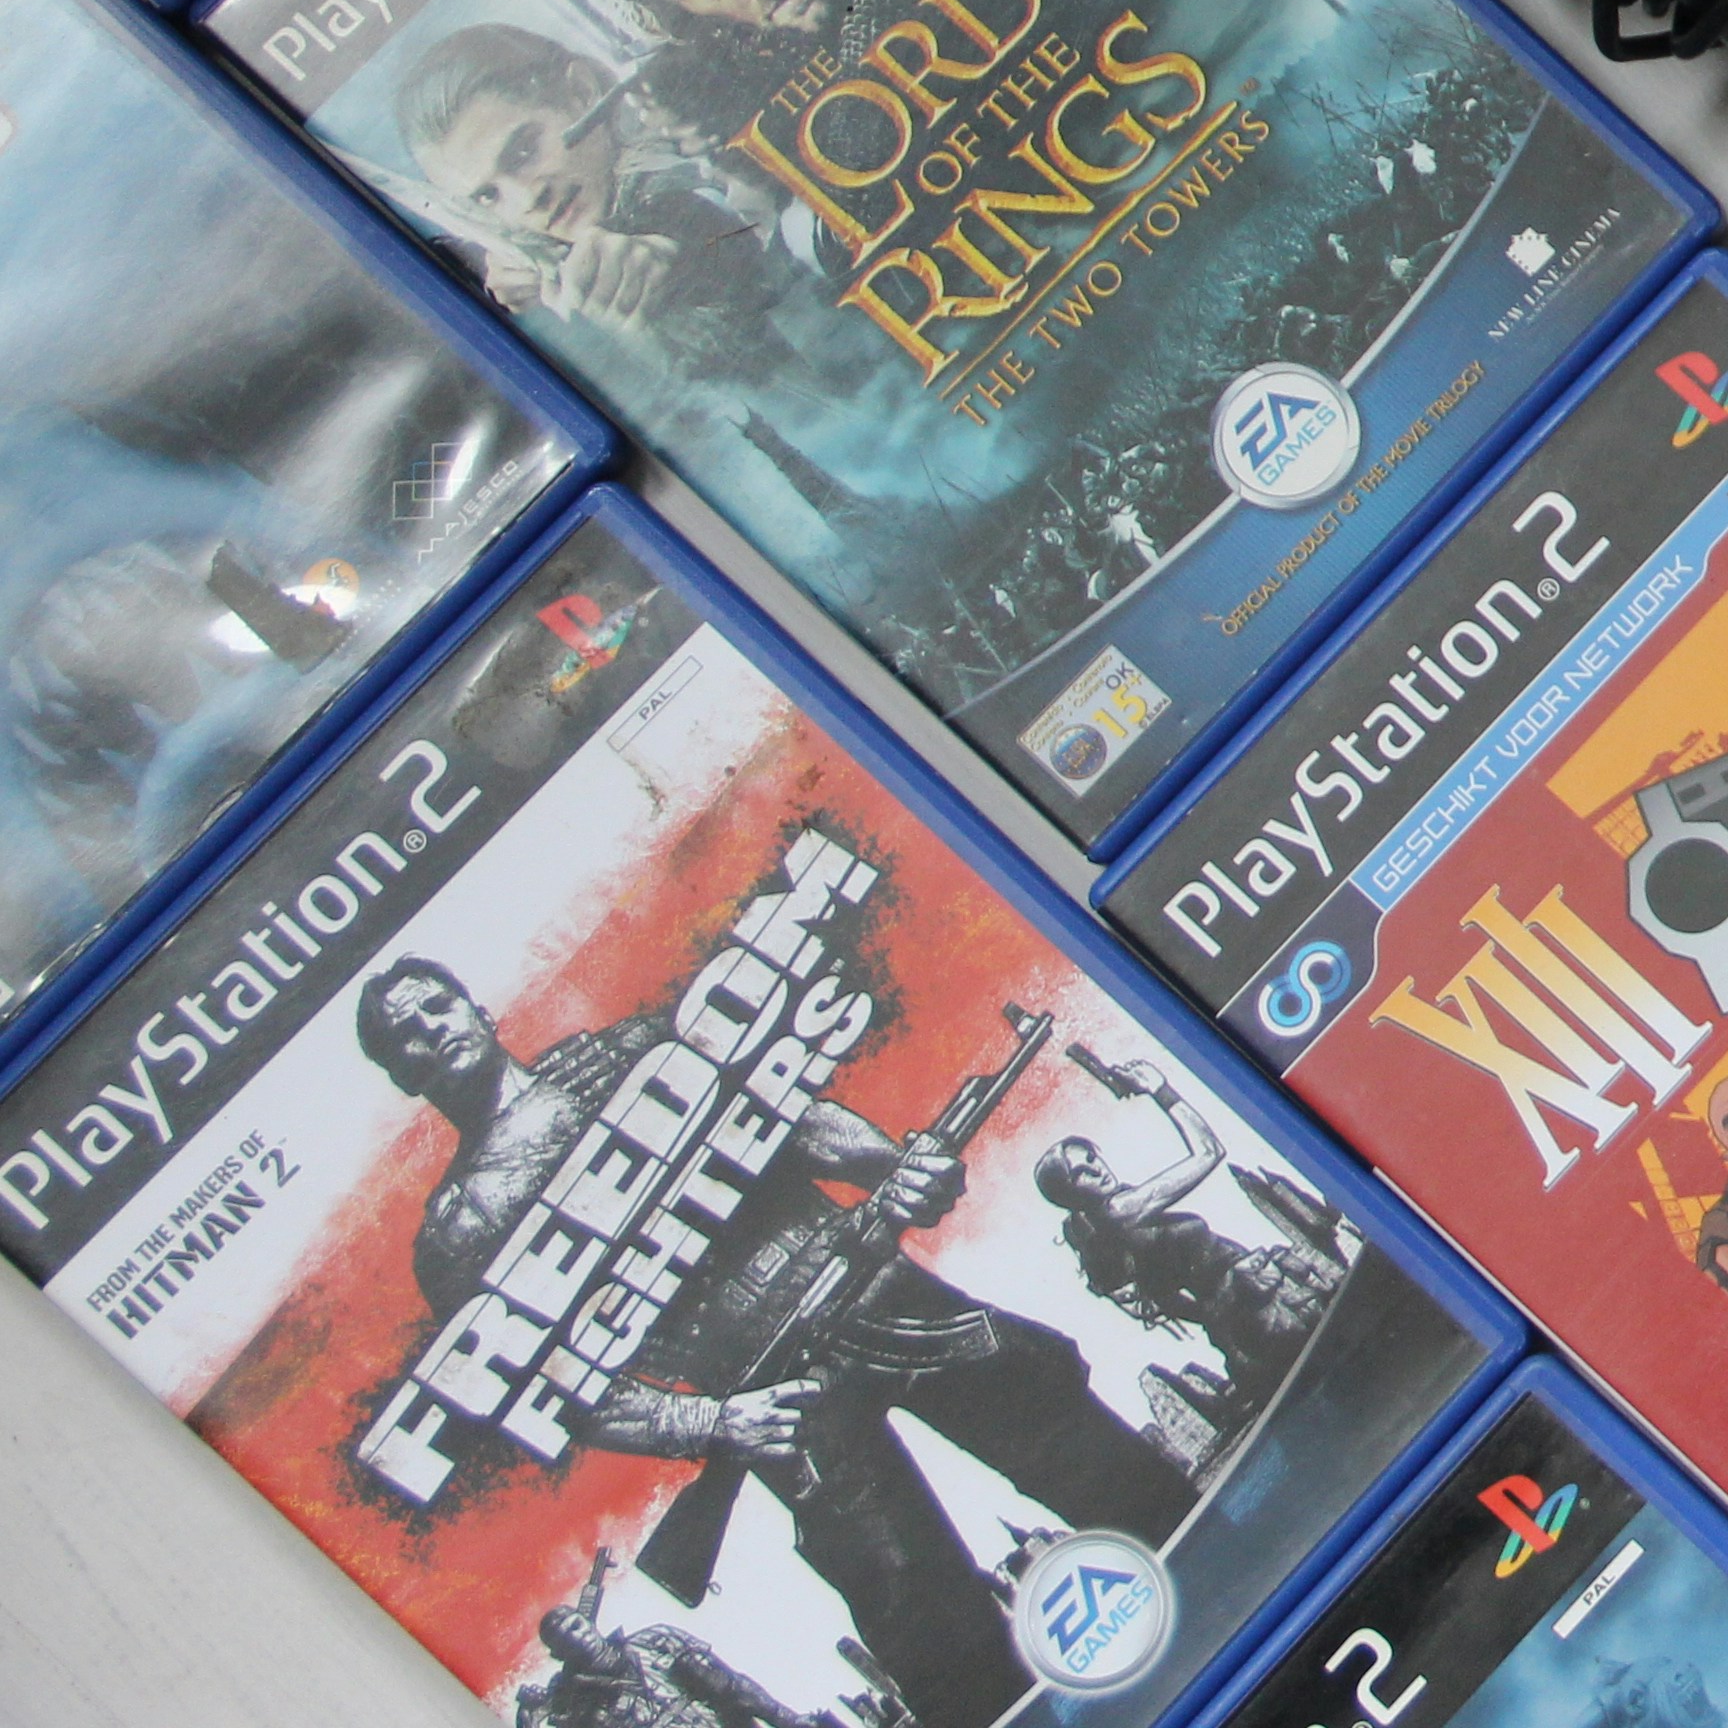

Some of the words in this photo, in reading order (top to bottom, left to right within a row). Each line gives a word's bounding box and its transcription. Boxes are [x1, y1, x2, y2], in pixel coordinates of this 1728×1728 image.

[769, 48, 843, 115] THE
[917, 122, 981, 196] OF
[976, 32, 1081, 132] THE
[837, 8, 1207, 389] RINGS
[953, 348, 1036, 428] THE
[1029, 260, 1123, 351] TWO
[1120, 110, 1272, 257] TOWERS
[1486, 303, 1525, 343] NEW
[1522, 264, 1563, 307] LINE
[1559, 203, 1622, 269] CINEMA
[1218, 573, 1282, 639] OFFICIAL
[1275, 510, 1342, 580] PRODUCT
[1334, 489, 1361, 517] OF
[1356, 460, 1389, 494] THE
[1381, 414, 1433, 469] MOVIE
[1424, 357, 1488, 423] TRILOGY
[1234, 390, 1319, 470] EA
[1256, 404, 1338, 488] GAMES
[413, 456, 520, 565] MAJESCO
[637, 688, 674, 722] PAL
[1106, 661, 1131, 691] OK
[1370, 764, 1498, 894] GESCHIKT
[1494, 682, 1569, 763] VOOR
[1567, 554, 1695, 693] NETWORK
[1368, 883, 1713, 1192] XIII
[84, 1256, 142, 1314] FROM
[133, 1222, 176, 1265] THE
[167, 1152, 245, 1230] MAKERS
[237, 1128, 270, 1161] OF
[358, 828, 880, 1505] FREEDOM
[500, 985, 875, 1461] FIGHTERS
[104, 1178, 268, 1341] HITMAN
[255, 1142, 303, 1190] 2
[1043, 1563, 1137, 1654] EA
[1065, 1581, 1154, 1677] GAMES
[1581, 1574, 1617, 1608] PAL
[1324, 1627, 1427, 1727] 2
